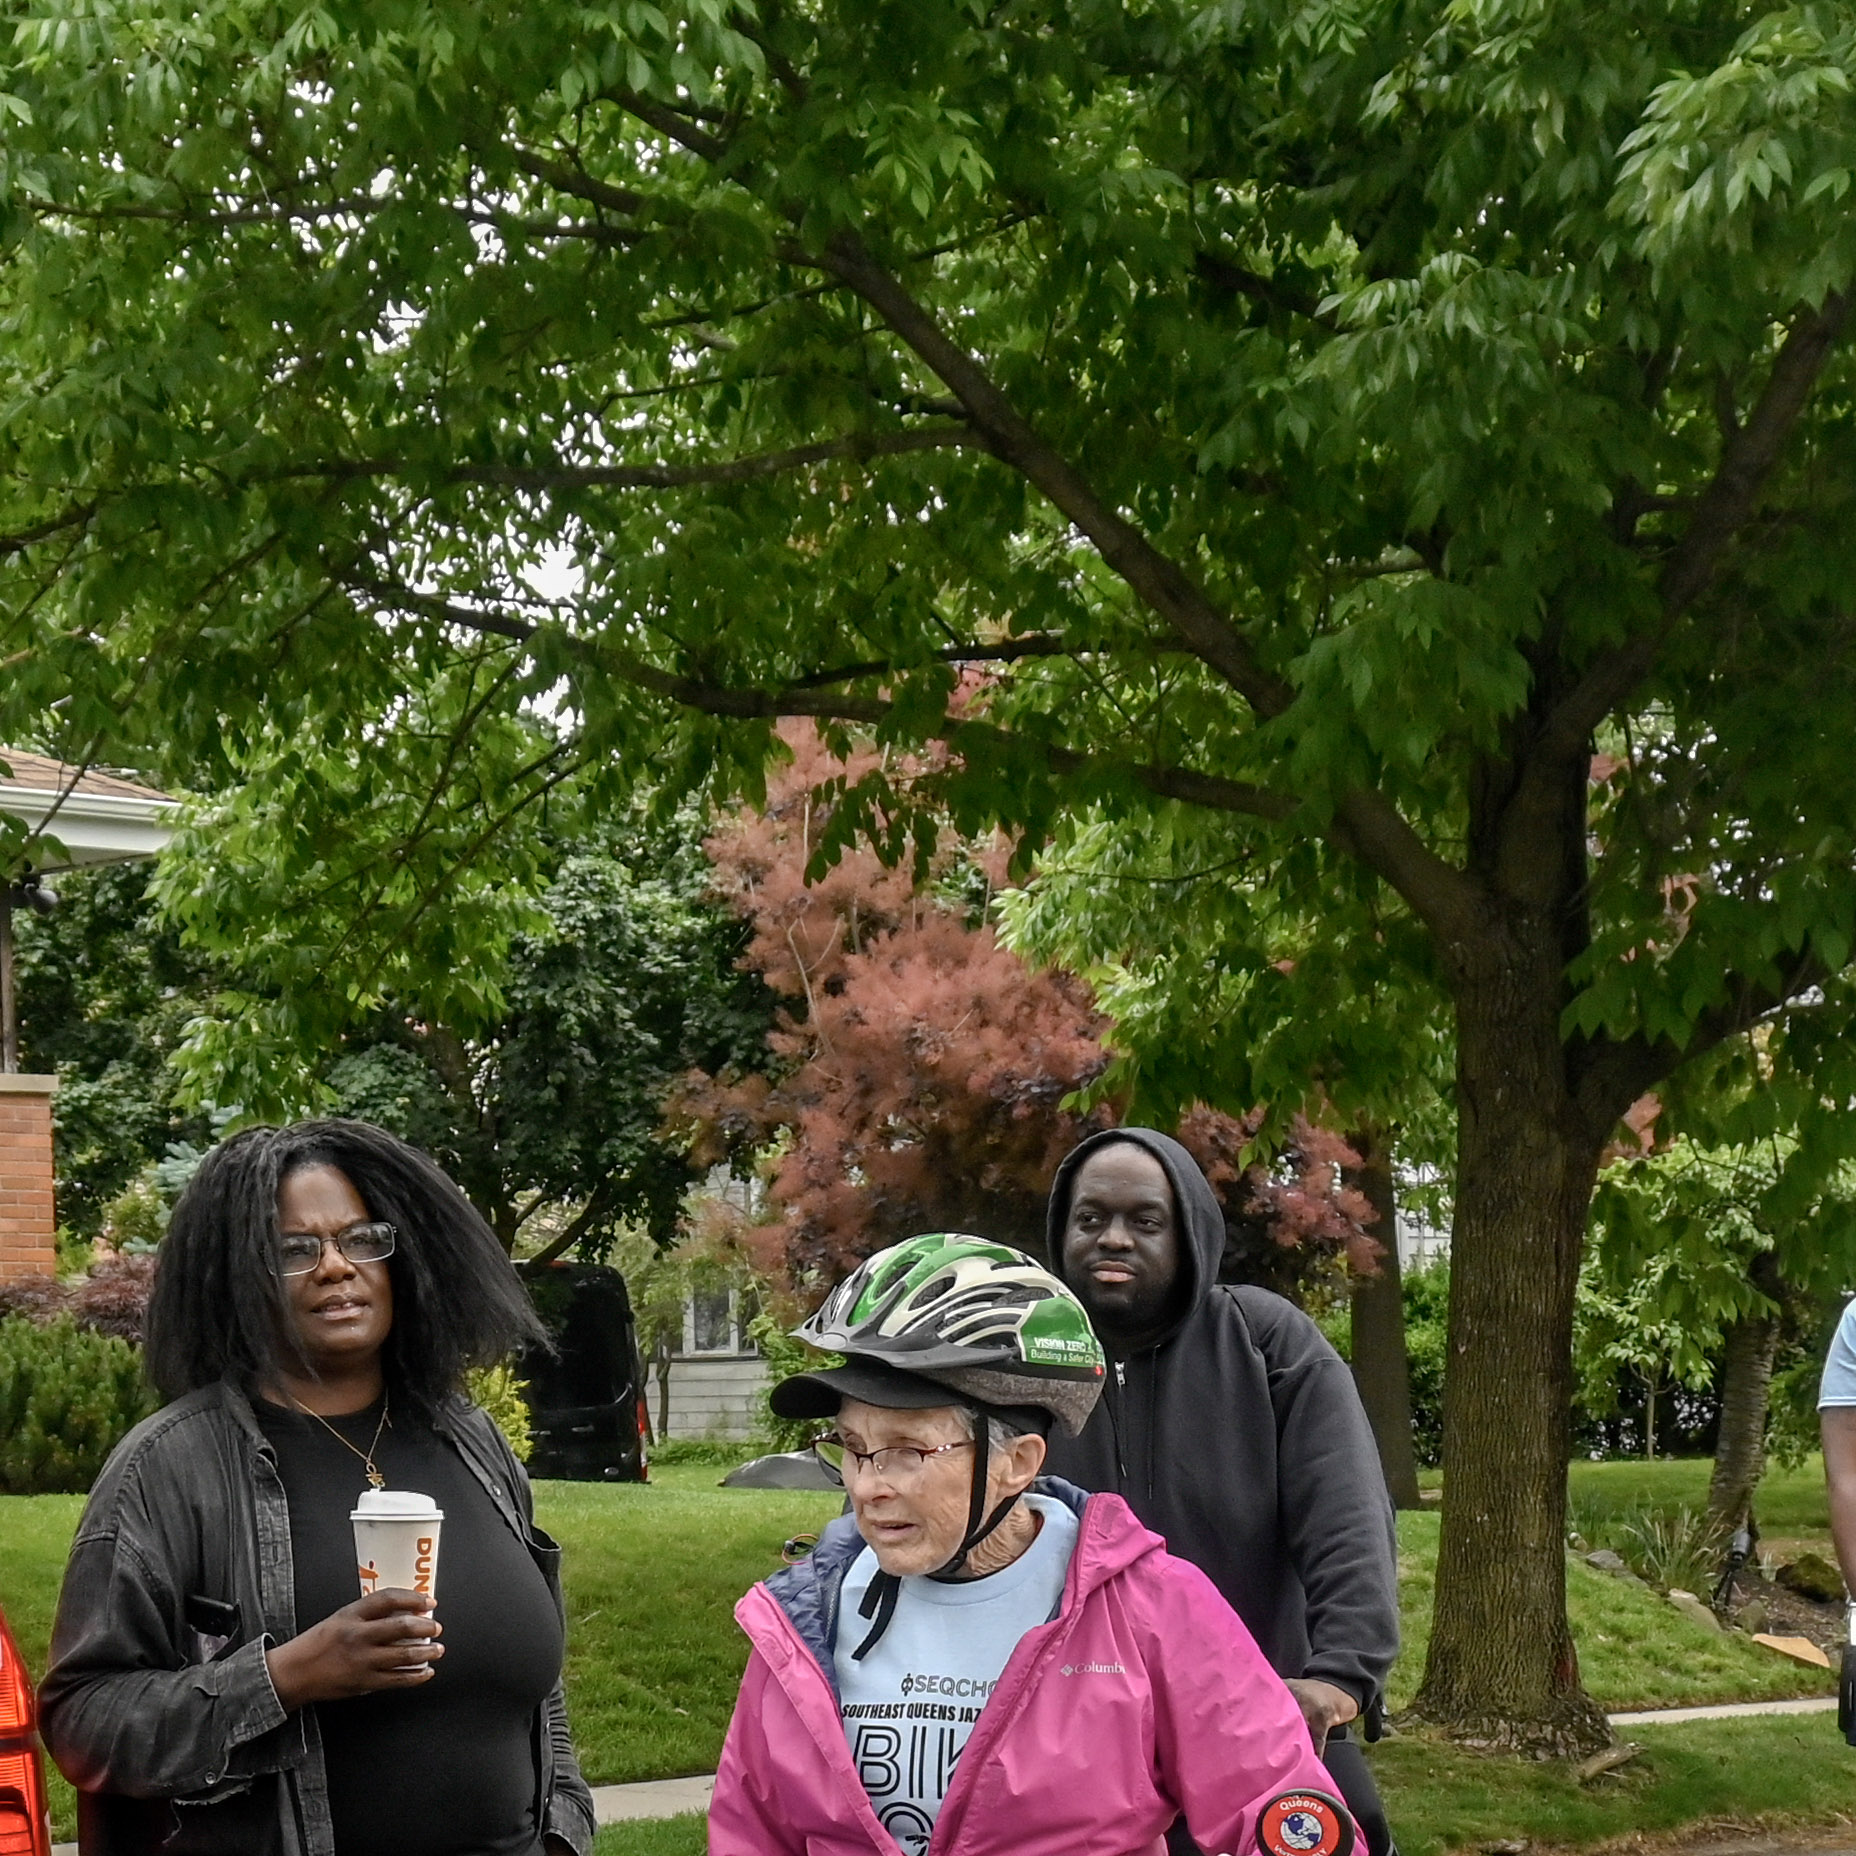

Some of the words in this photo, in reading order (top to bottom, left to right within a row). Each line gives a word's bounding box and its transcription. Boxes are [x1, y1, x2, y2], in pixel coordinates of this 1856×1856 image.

[1033, 1337, 1065, 1350] VISION
[1066, 1340, 1086, 1352] ZERO
[1030, 1349, 1062, 1362] Building
[1068, 1353, 1084, 1363] Safer
[842, 1703, 905, 1719] SOUTHEAST
[906, 1703, 956, 1722] QUEENS
[1279, 1800, 1324, 1814] Queens
